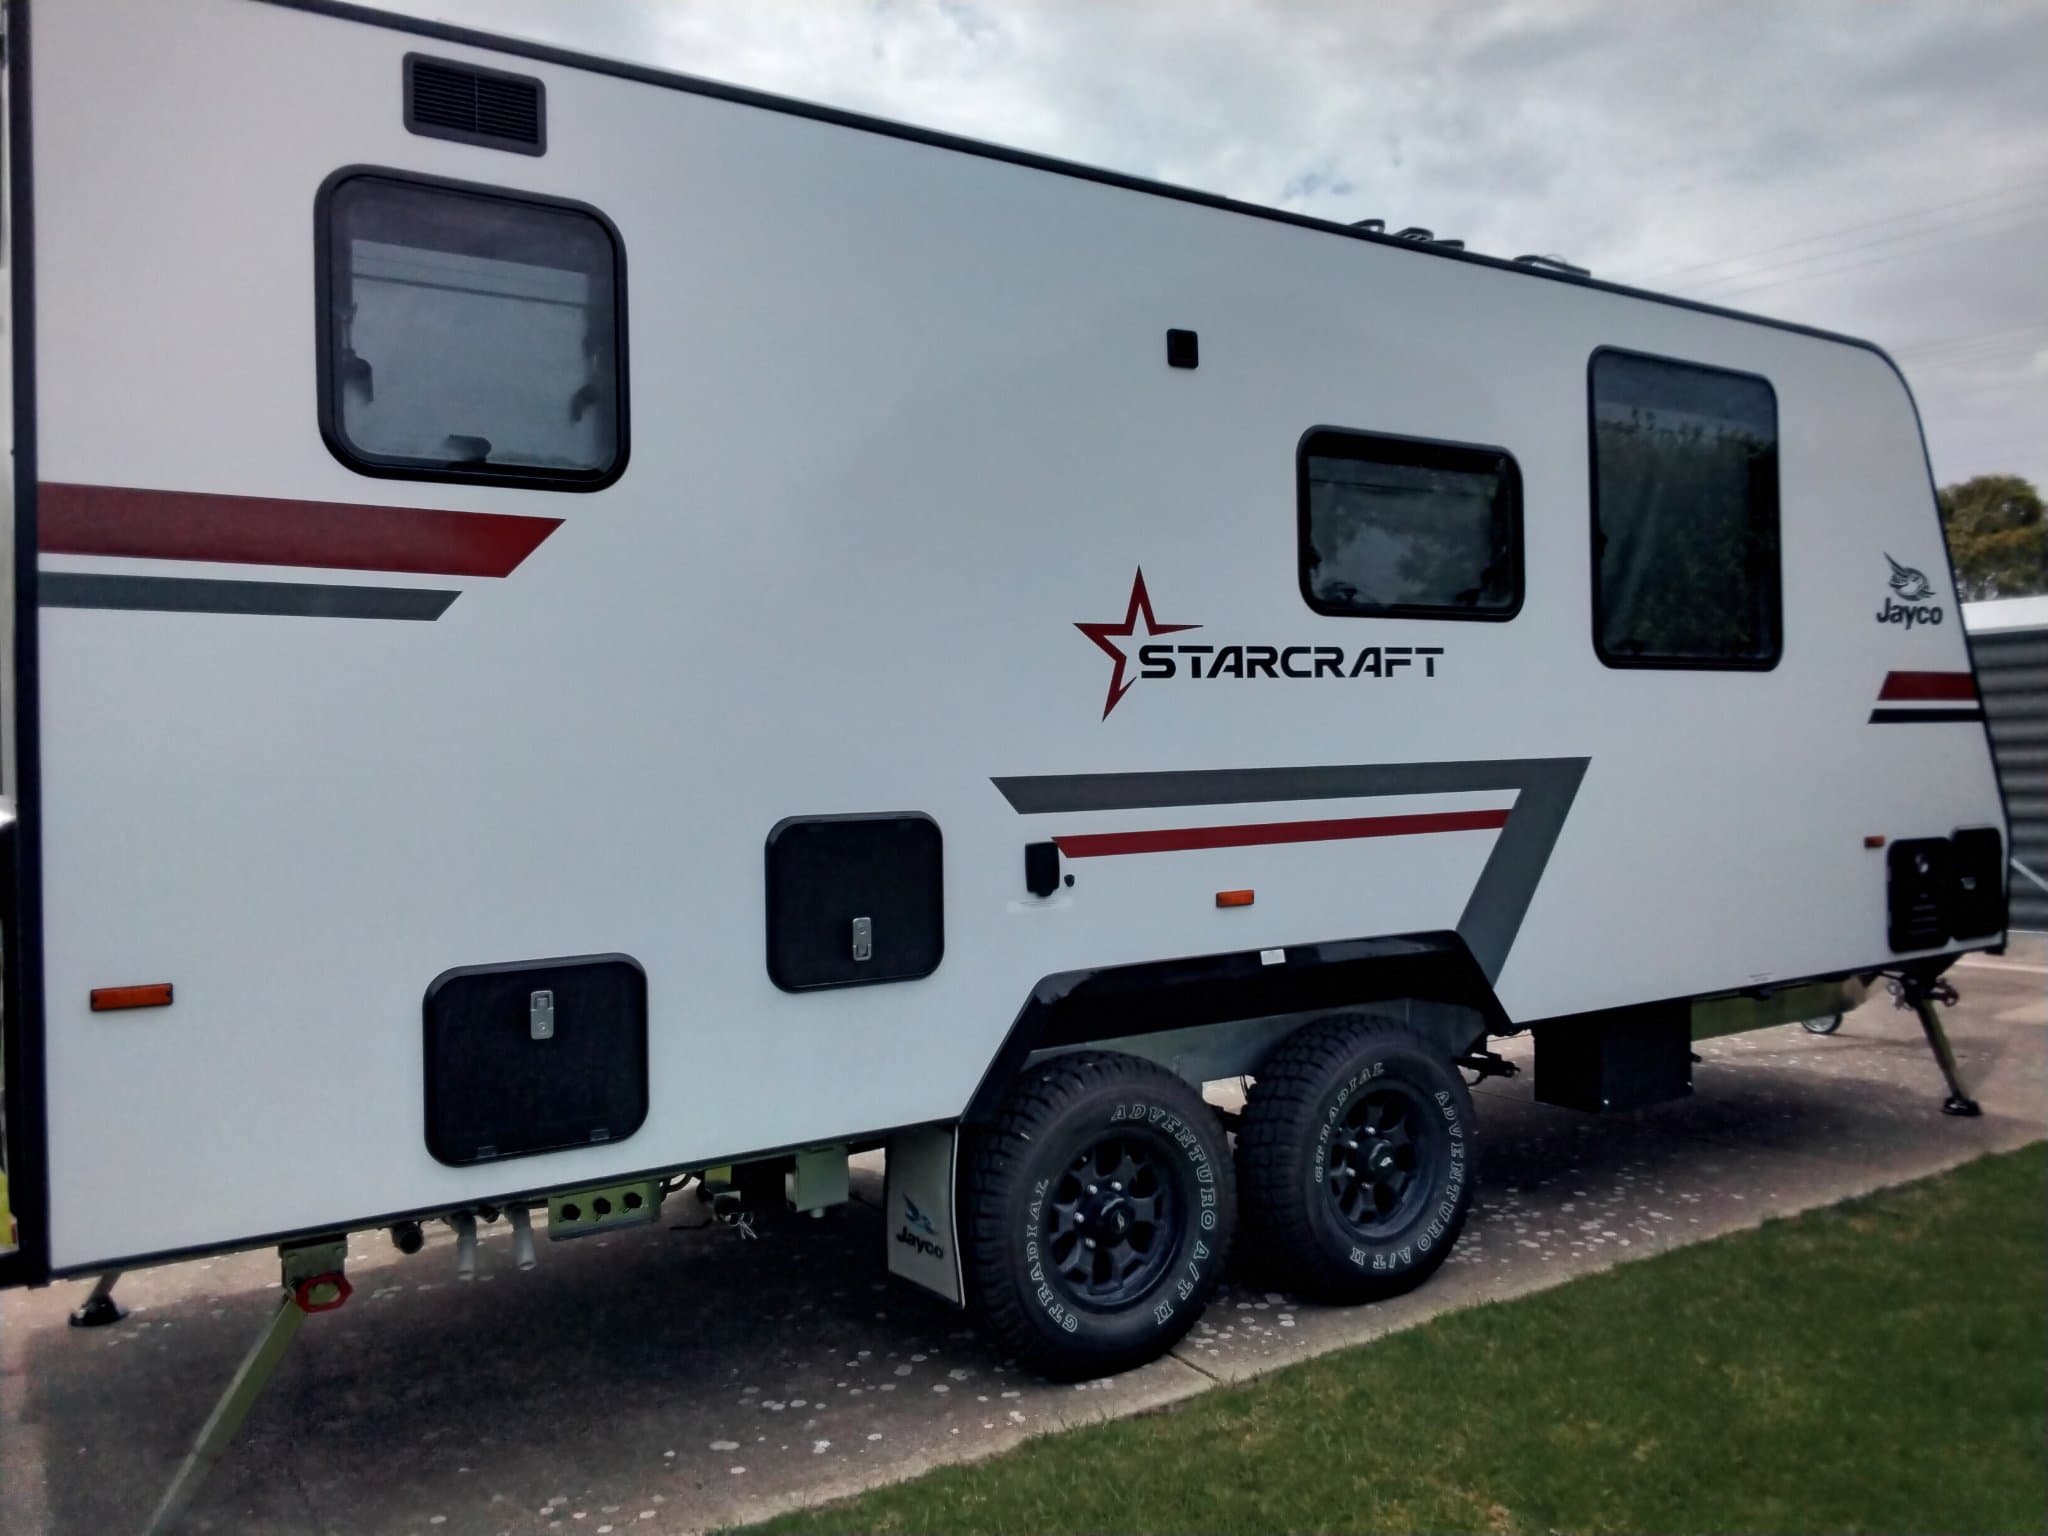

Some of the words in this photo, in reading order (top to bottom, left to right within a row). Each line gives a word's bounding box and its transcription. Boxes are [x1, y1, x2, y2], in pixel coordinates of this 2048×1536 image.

[1876, 597, 1943, 630] Jayco
[1138, 645, 1445, 679] STARCRAFT
[1111, 1103, 1216, 1230] ADVENTURO
[1417, 1090, 1465, 1252] ADVENTURO
[896, 1226, 944, 1259] Jayco
